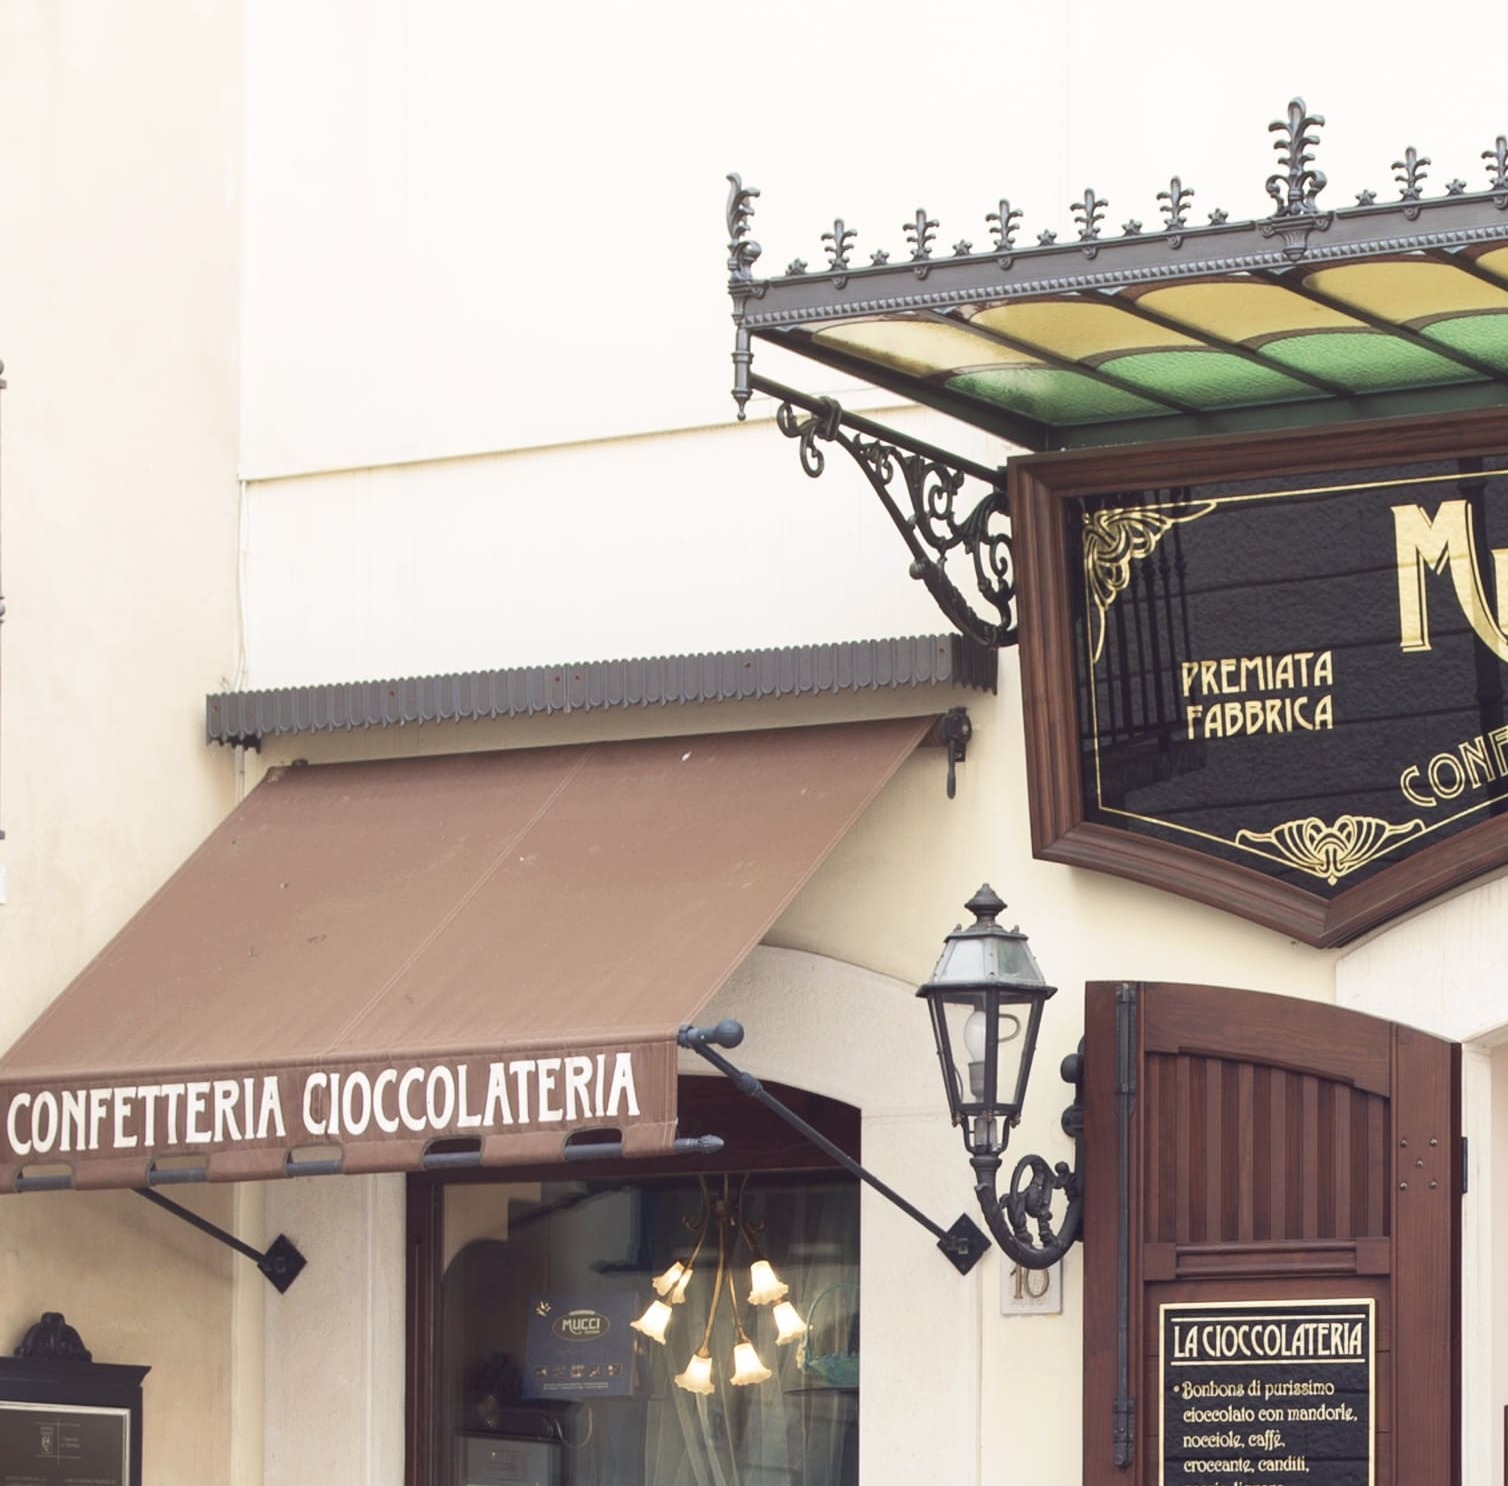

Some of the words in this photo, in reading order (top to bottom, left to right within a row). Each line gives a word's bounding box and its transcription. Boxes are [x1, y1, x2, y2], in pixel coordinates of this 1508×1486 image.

[1181, 651, 1334, 696] PREMIATA
[1187, 694, 1334, 740] FABBRICA
[6, 1076, 286, 1155] CONFETTERIA
[302, 1052, 640, 1136] CIOCCOLATERIA
[1010, 1263, 1050, 1299] 10
[1174, 1325, 1198, 1357] LA
[1202, 1322, 1363, 1357] CIOCCOLATERIA
[1182, 1380, 1244, 1400] Bonbons
[1247, 1380, 1261, 1396] di
[1264, 1380, 1335, 1401] purissimo
[1183, 1405, 1255, 1422] cioccolato
[1258, 1408, 1284, 1421] con
[1287, 1403, 1358, 1422] mandorle,
